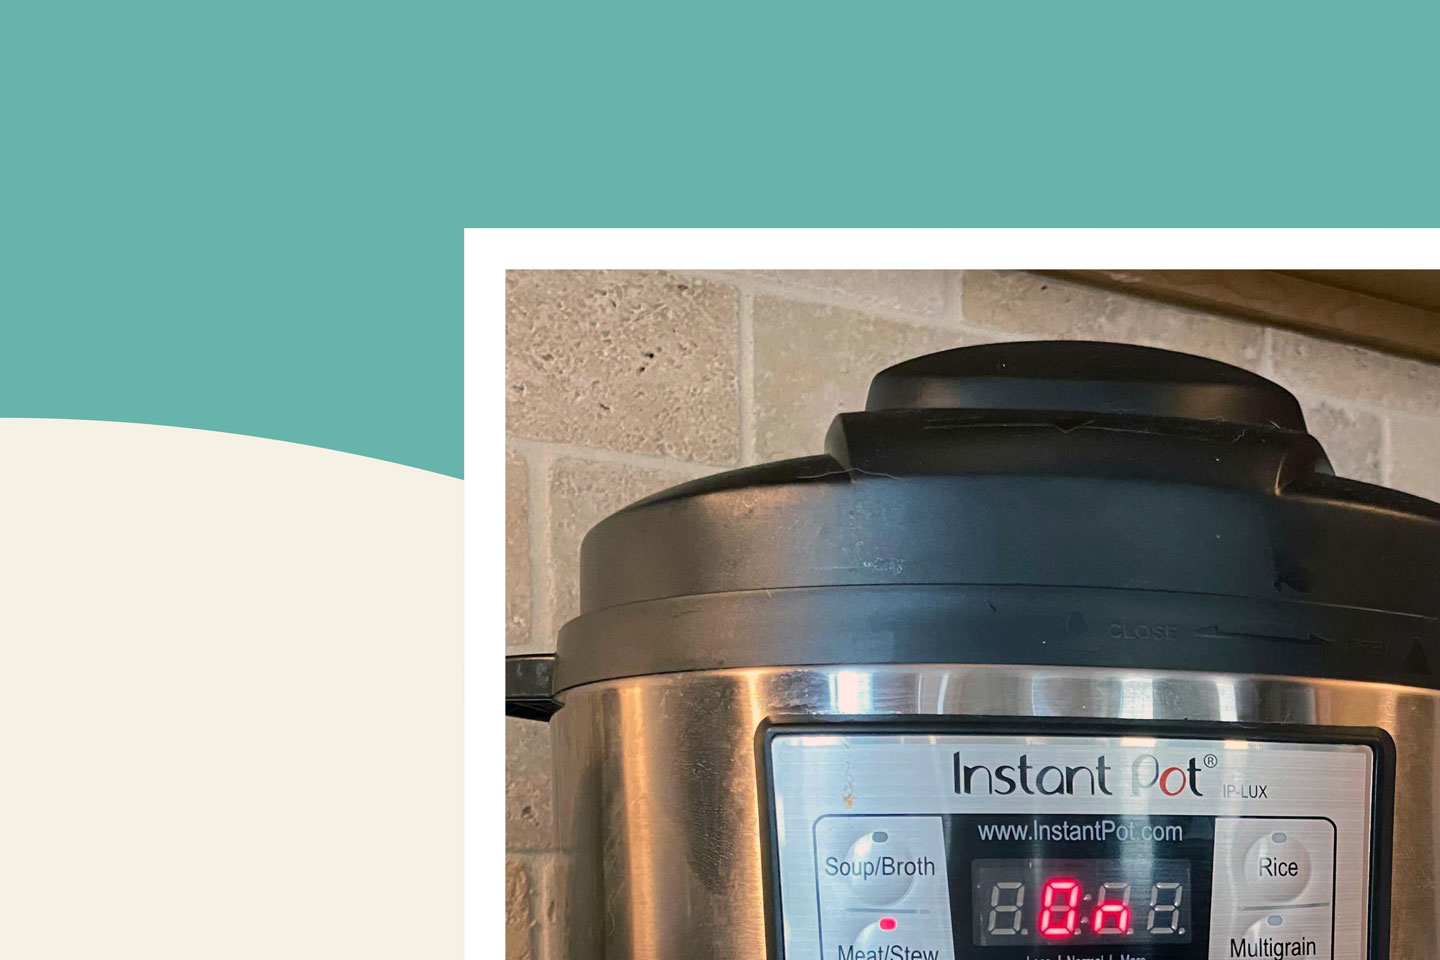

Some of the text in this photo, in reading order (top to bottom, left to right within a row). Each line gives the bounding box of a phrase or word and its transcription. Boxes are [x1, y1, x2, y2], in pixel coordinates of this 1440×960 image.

[1108, 623, 1178, 641] CLOSE
[953, 751, 1113, 796] Instant
[1222, 783, 1268, 799] IP-LUX
[977, 820, 1183, 843] www.InstantPot.com
[825, 855, 936, 878] Soup/Broth
[1260, 857, 1299, 877] Rice
[1229, 937, 1317, 960] Multigrain
